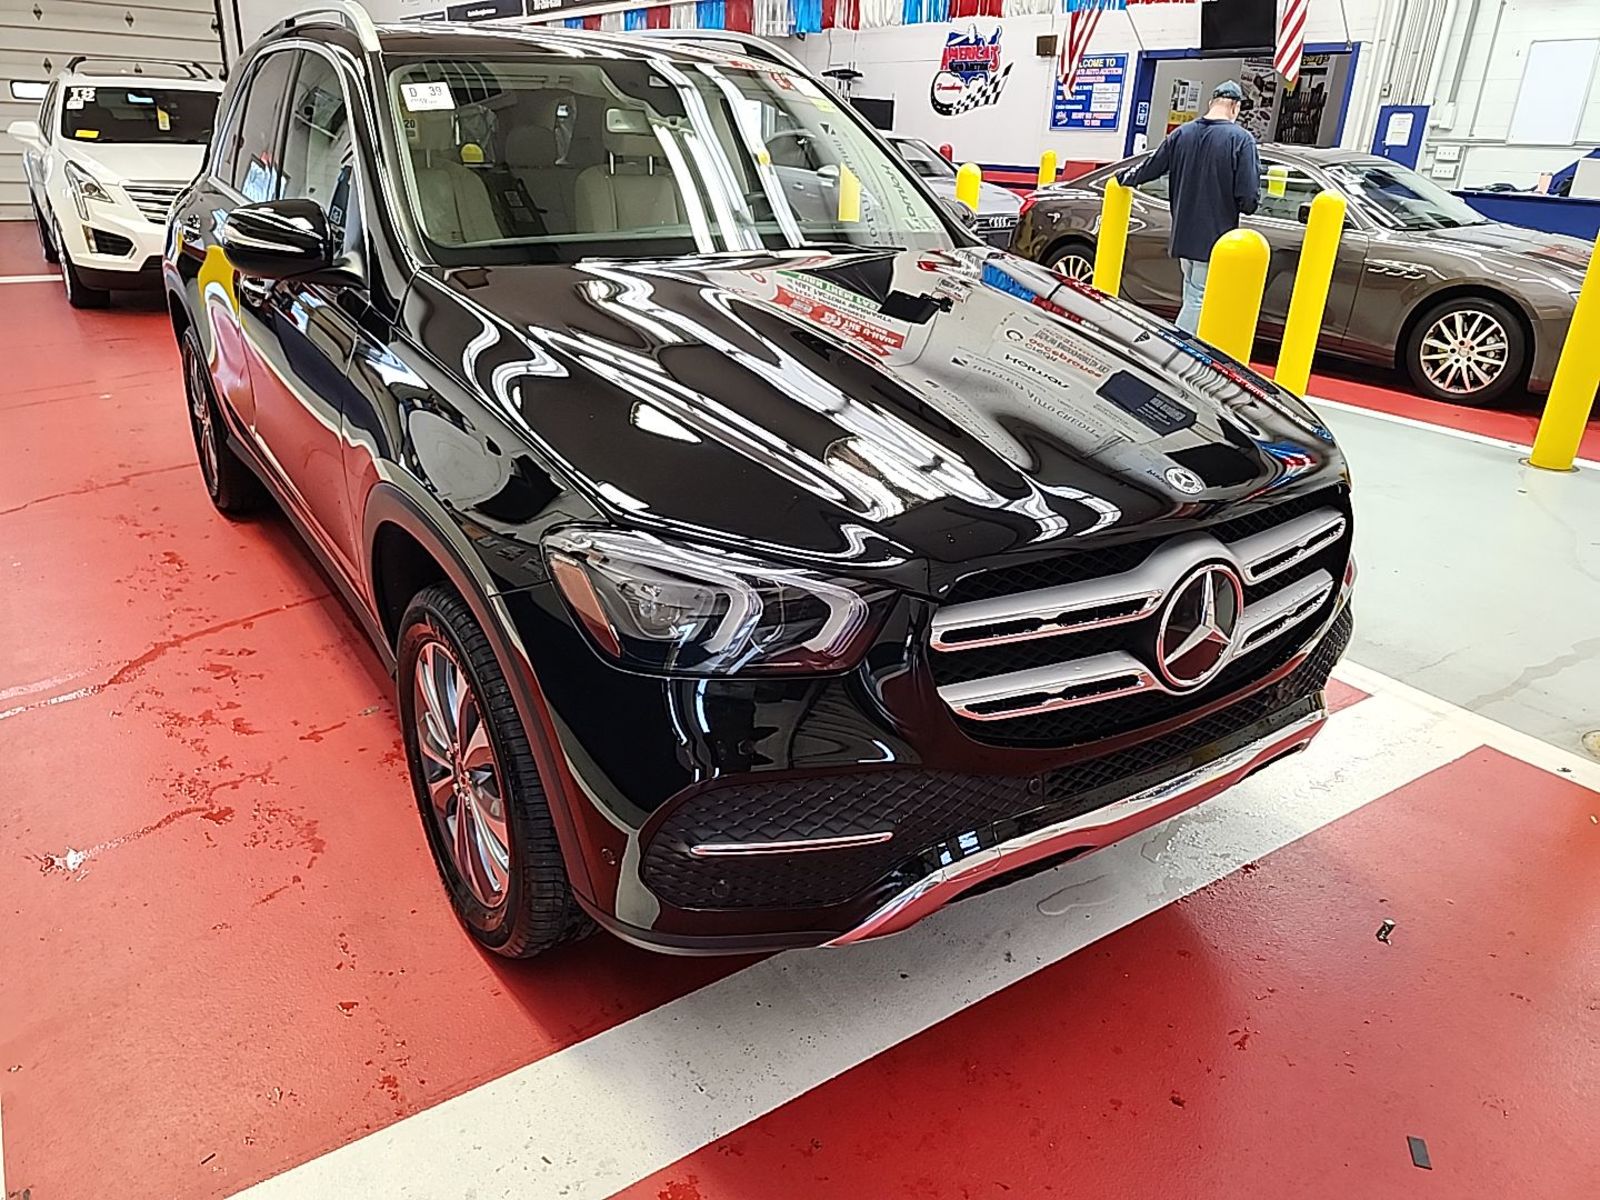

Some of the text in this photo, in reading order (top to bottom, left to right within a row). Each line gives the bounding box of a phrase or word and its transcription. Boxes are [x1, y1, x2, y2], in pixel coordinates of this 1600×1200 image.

[1106, 58, 1116, 67] TO
[408, 86, 442, 97] D 39
[403, 119, 416, 129] 20
